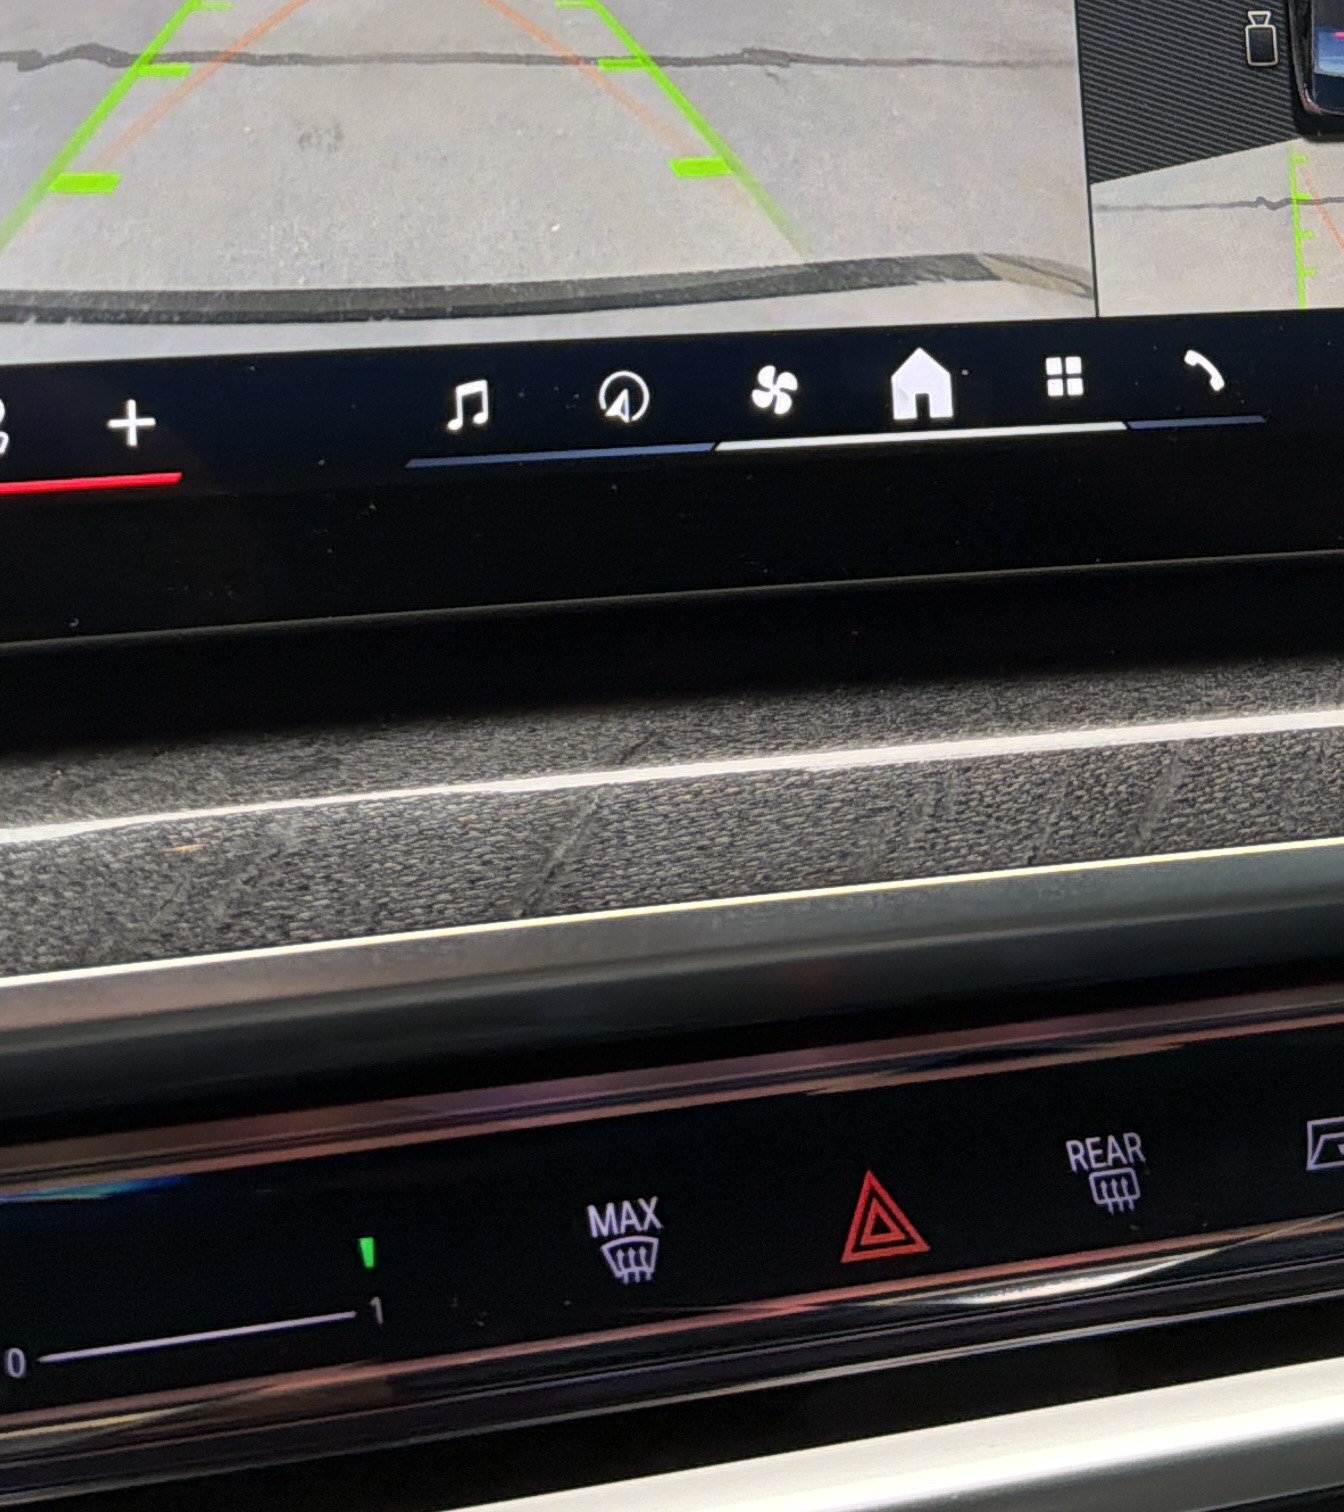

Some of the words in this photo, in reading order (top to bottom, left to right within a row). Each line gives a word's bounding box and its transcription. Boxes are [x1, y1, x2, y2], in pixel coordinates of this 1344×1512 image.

[1065, 1133, 1146, 1172] REAR
[588, 1197, 662, 1238] MAX
[369, 1298, 383, 1324] 1
[3, 1347, 27, 1379] 0
